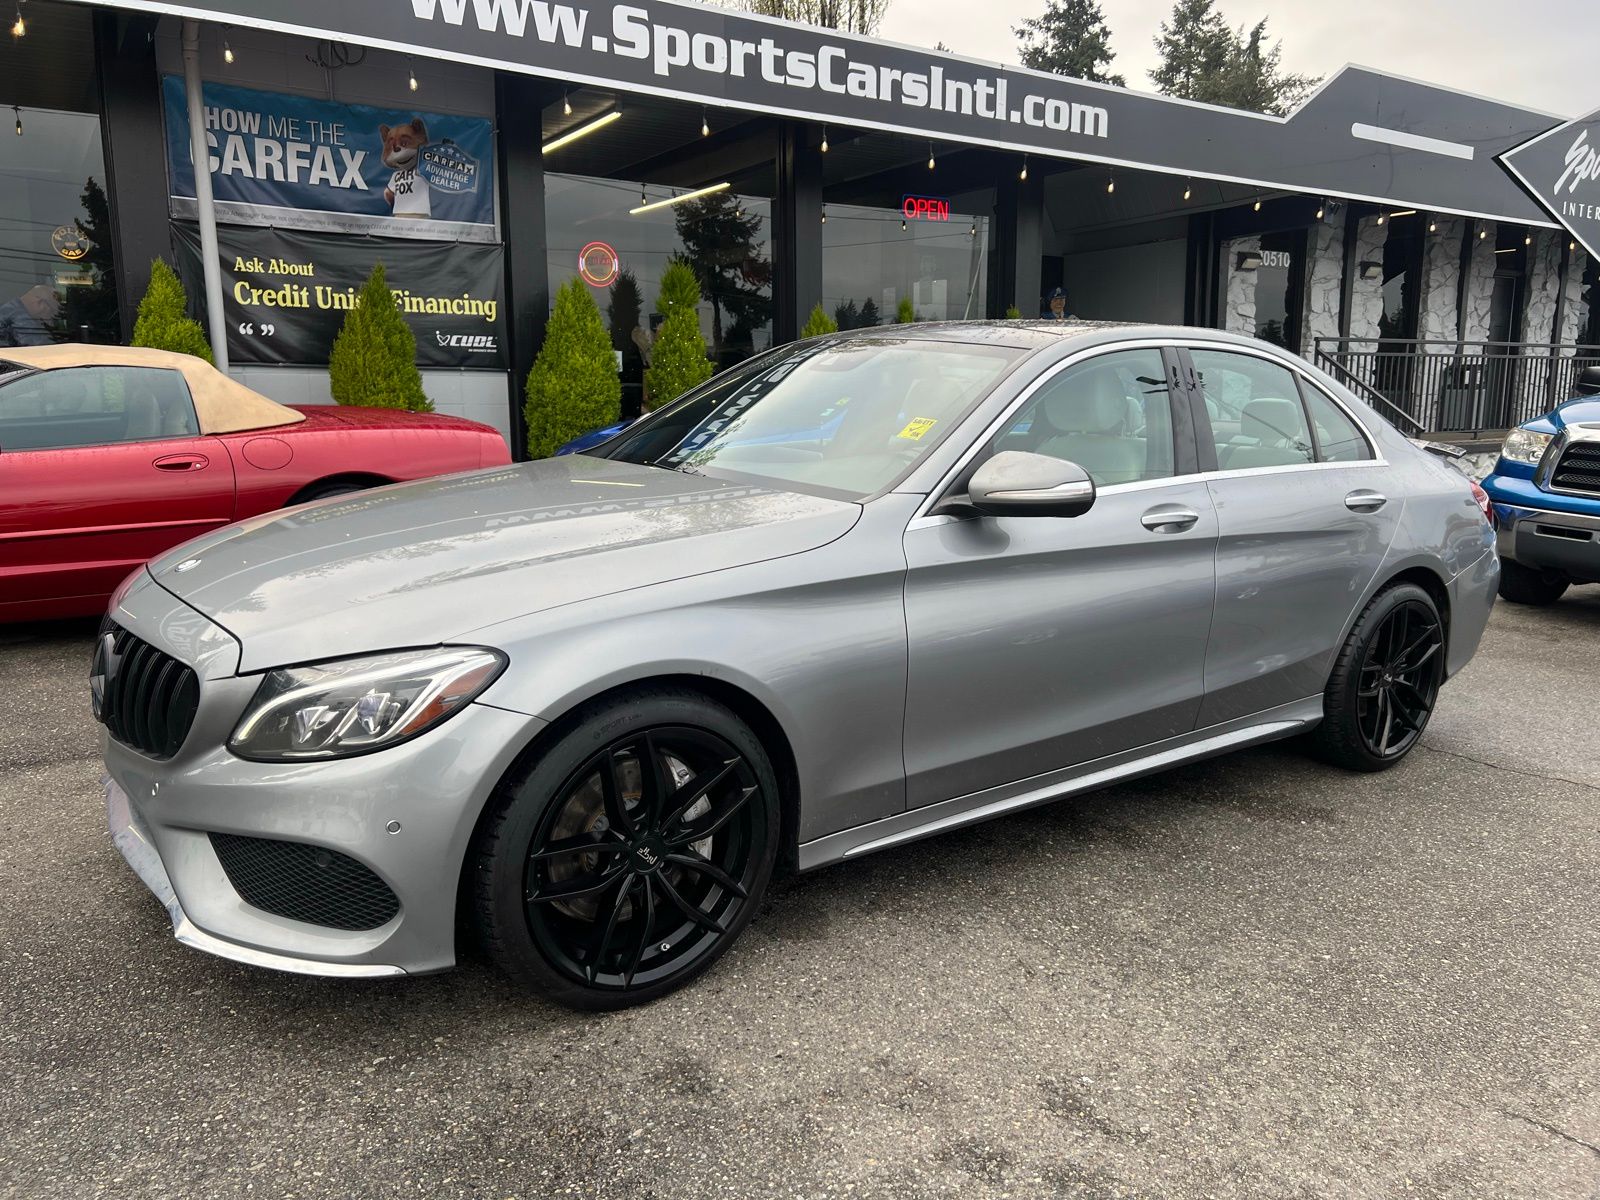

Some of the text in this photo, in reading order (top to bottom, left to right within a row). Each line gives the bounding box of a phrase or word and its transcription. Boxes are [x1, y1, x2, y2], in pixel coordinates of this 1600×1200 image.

[187, 106, 345, 146] HOW ME THE
[423, 152, 474, 175] CARFAX
[425, 164, 470, 184] ADVANTAGE
[394, 169, 414, 183] CAR
[431, 175, 461, 190] DEALER
[394, 182, 414, 196] FOX
[904, 197, 949, 222] OPEN
[233, 256, 314, 277] Ask About
[233, 281, 309, 308] Credit
[315, 285, 363, 310] Uni
